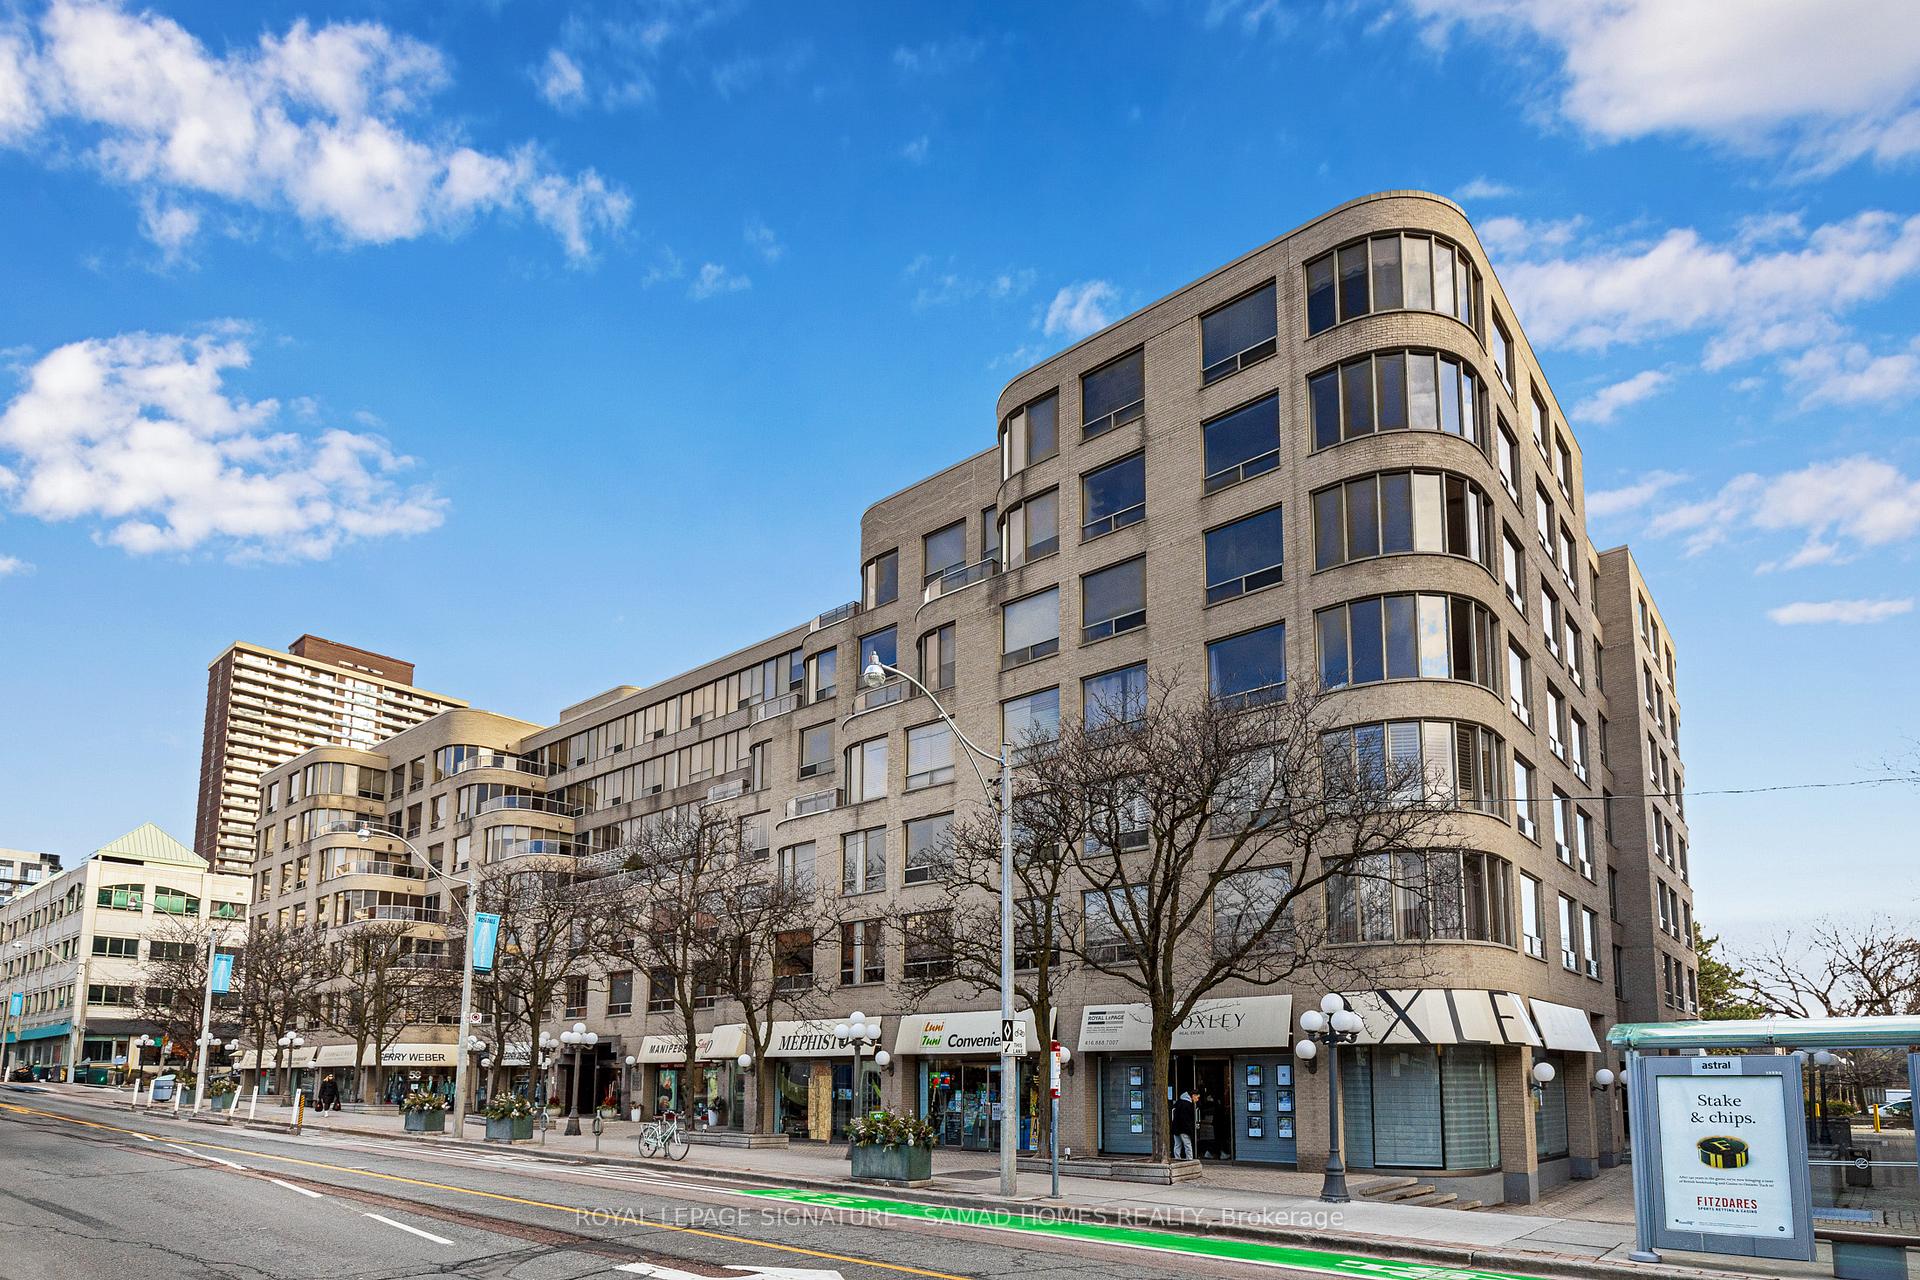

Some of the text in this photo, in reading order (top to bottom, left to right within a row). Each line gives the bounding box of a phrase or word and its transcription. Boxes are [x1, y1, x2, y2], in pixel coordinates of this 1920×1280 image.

[924, 1021, 945, 1032] Luni
[1180, 1013, 1246, 1030] OXLEY
[921, 1035, 942, 1046] Tuni
[948, 1031, 1001, 1048] Convenie
[409, 1053, 446, 1062] WEBER
[1702, 1061, 1731, 1070] astral
[1698, 1094, 1742, 1107] Stake
[1691, 1111, 1756, 1128] & chips.
[1697, 1196, 1758, 1209] FITZDARES
